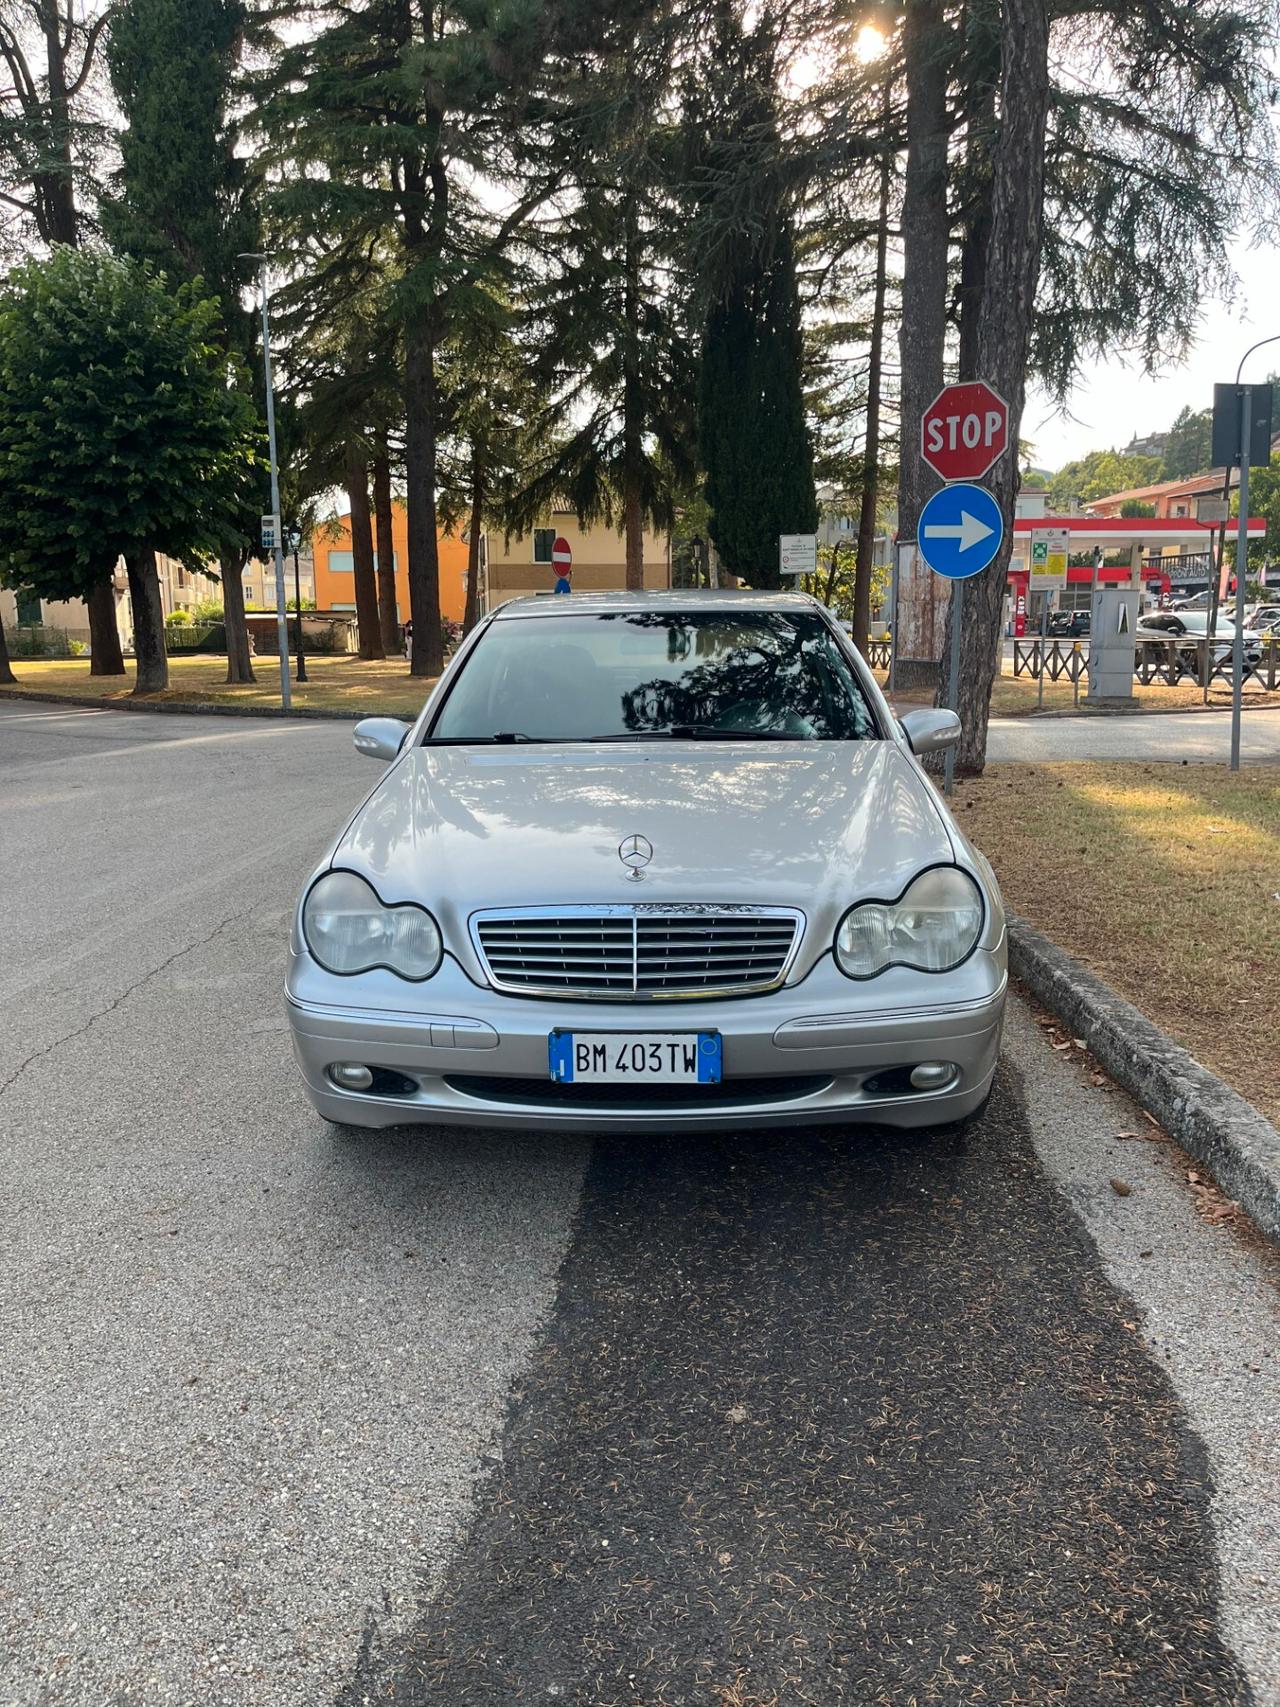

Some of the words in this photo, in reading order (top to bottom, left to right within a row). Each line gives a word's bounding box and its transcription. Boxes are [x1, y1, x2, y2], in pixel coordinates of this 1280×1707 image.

[927, 411, 1002, 453] STOP
[576, 1043, 607, 1073] BM
[615, 1043, 697, 1073] 403TW
